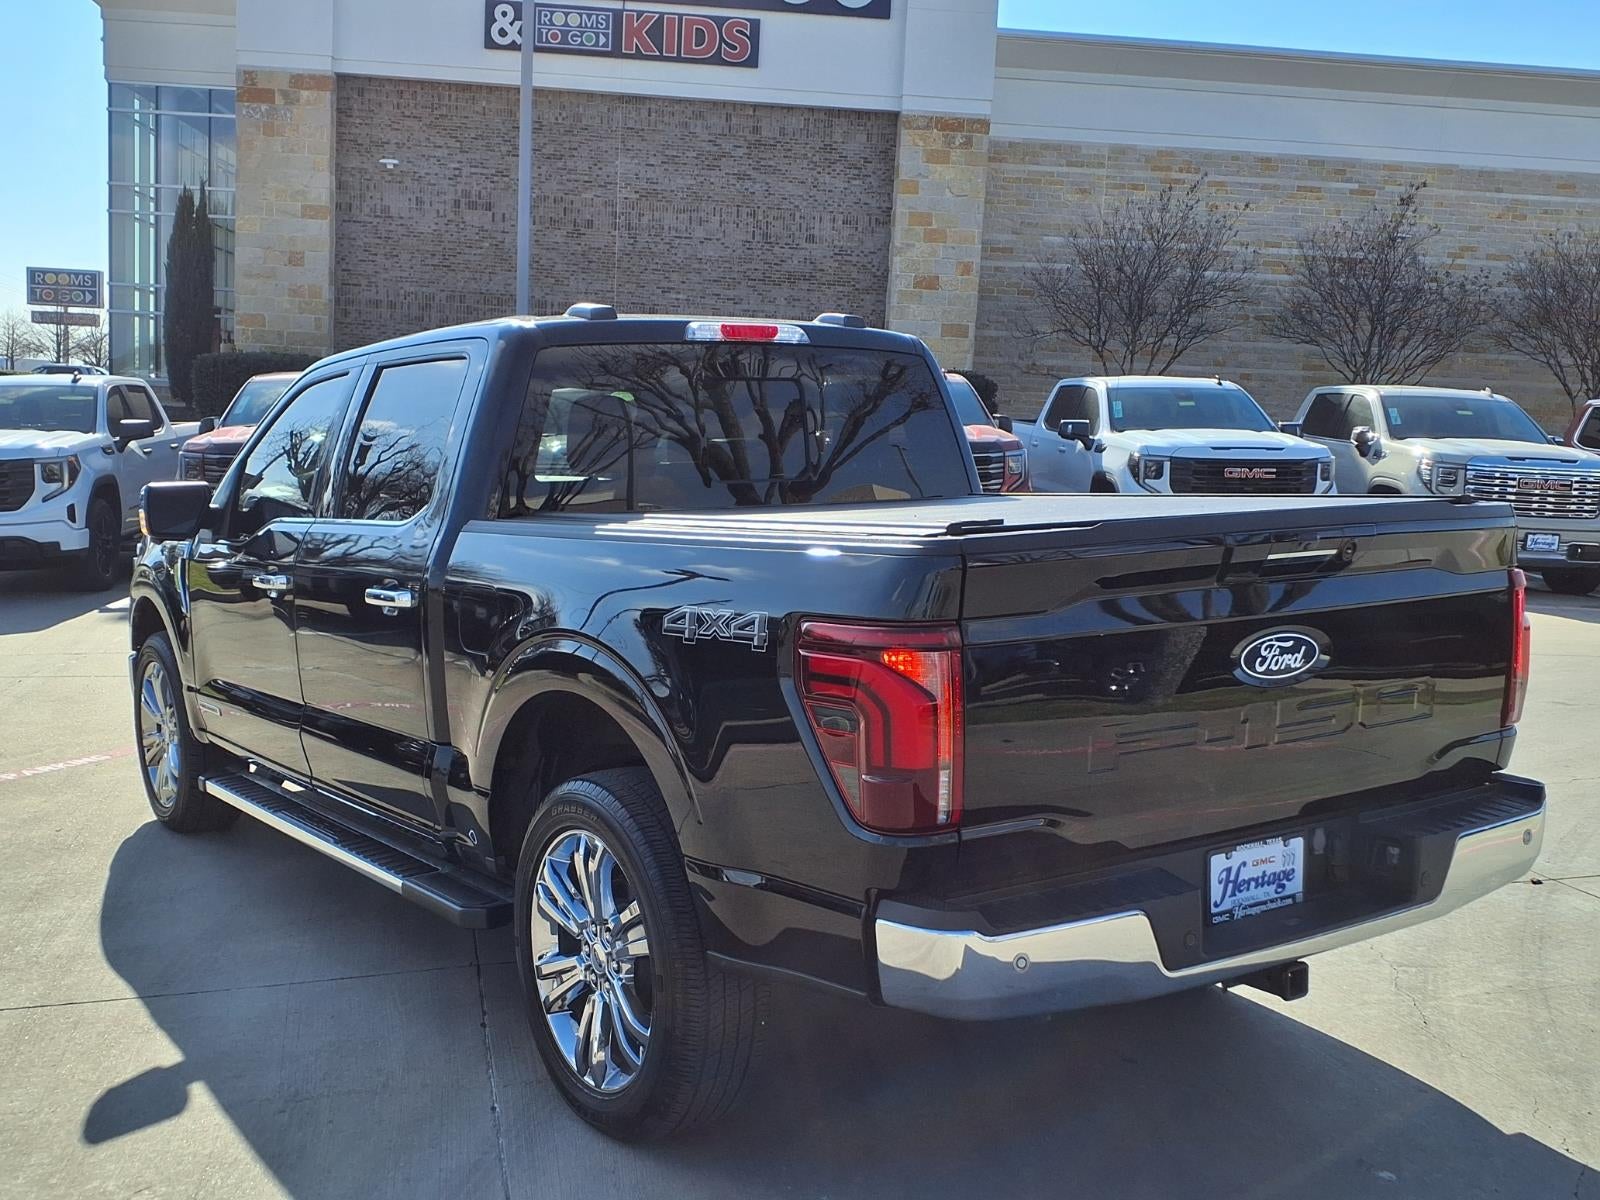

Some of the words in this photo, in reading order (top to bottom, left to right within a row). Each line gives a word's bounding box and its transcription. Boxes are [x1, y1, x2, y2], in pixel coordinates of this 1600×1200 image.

[540, 11, 606, 29] ROOMS
[540, 29, 561, 43] TO
[568, 31, 596, 46] GO
[621, 12, 751, 62] KIDS
[34, 272, 92, 286] ROOMS
[32, 288, 54, 301] TO
[59, 290, 83, 302] GO
[1224, 467, 1277, 479] GMC
[1519, 479, 1571, 491] GMC
[1255, 640, 1306, 672] Ford
[1252, 855, 1276, 867] GMC
[1213, 861, 1296, 908] Heritage
